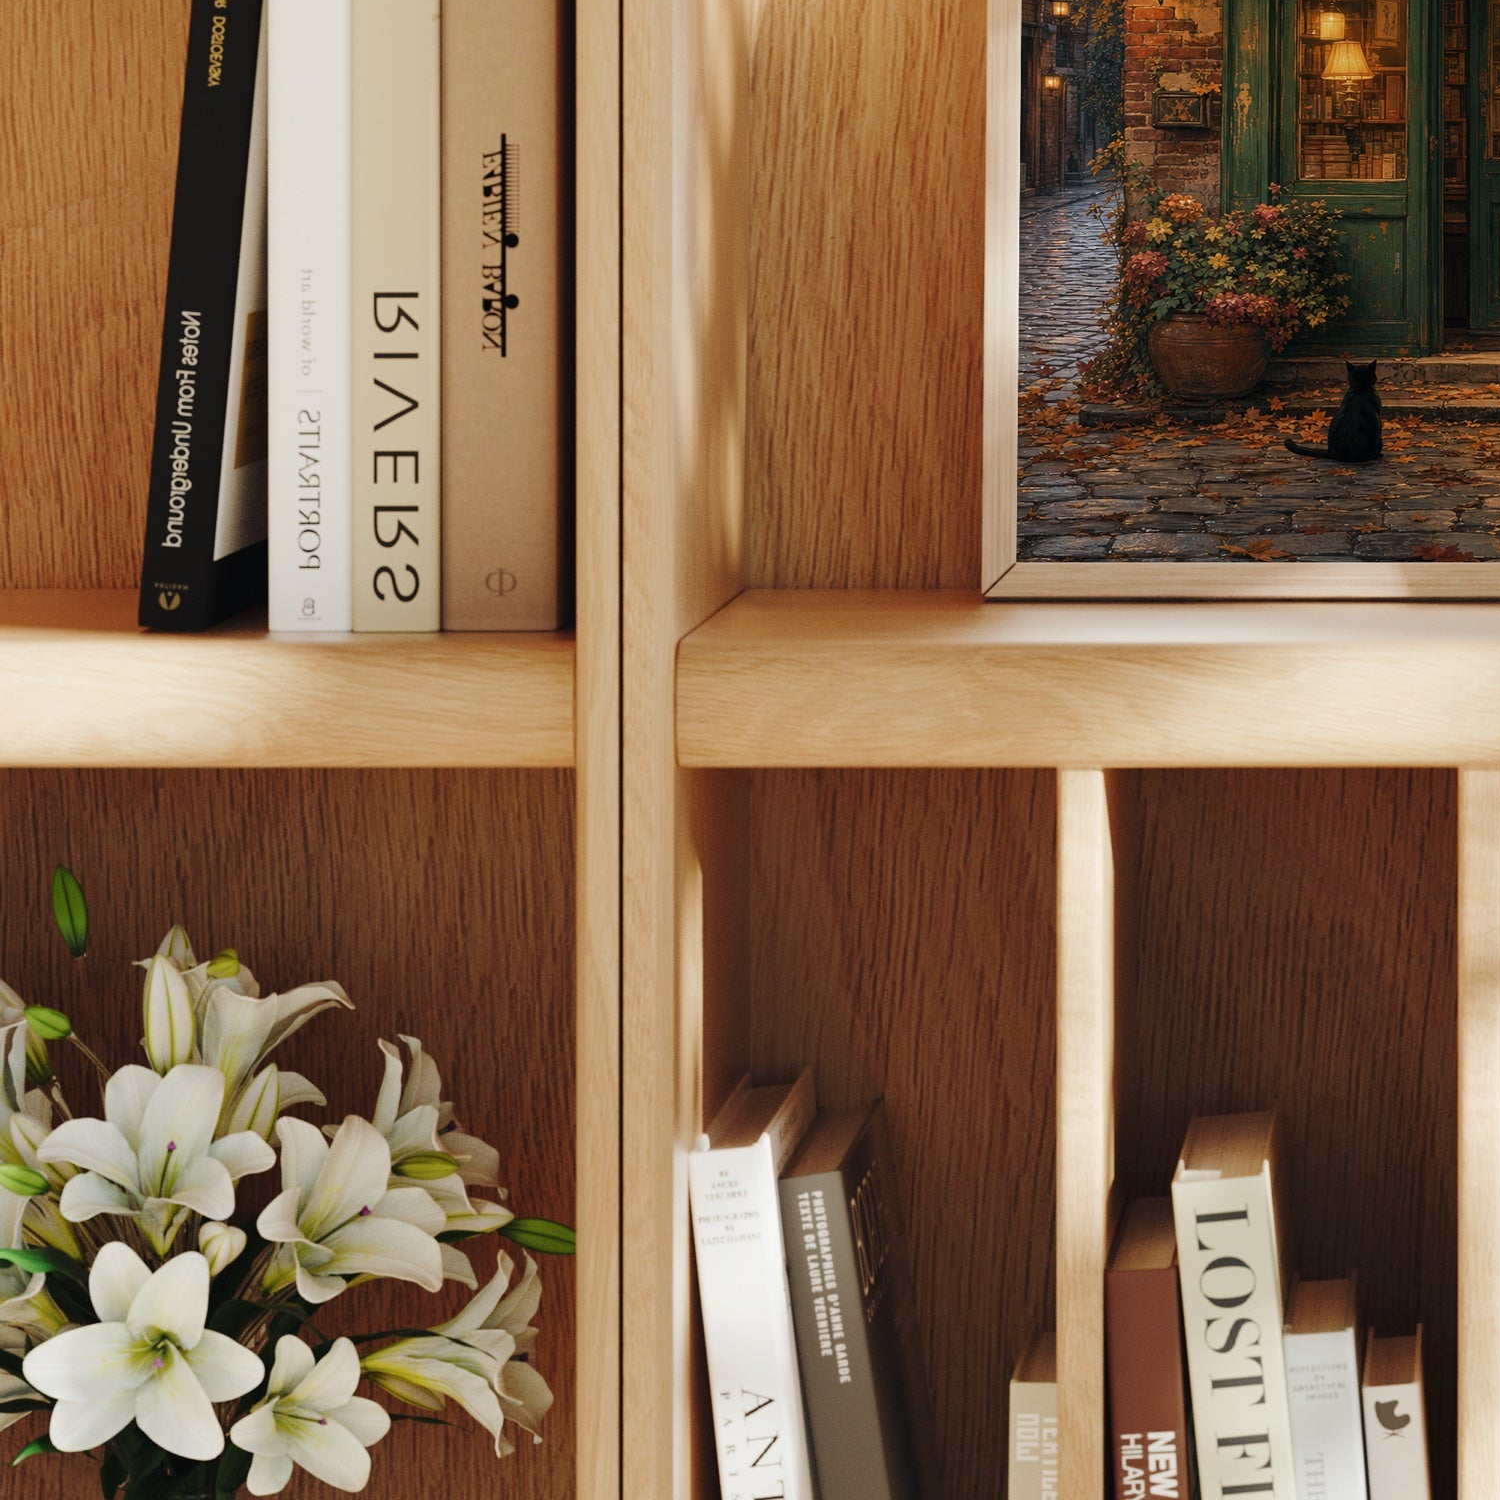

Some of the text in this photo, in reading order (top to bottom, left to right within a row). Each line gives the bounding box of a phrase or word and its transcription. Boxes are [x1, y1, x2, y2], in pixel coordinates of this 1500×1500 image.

[797, 1192, 833, 1357] TEXTE DE LAURE VERNIERE
[812, 1190, 851, 1384] PHOTOGRAPHIES D'ANNE GARDE
[1194, 1203, 1266, 1406] LOST
[1147, 1430, 1179, 1498] NEW
